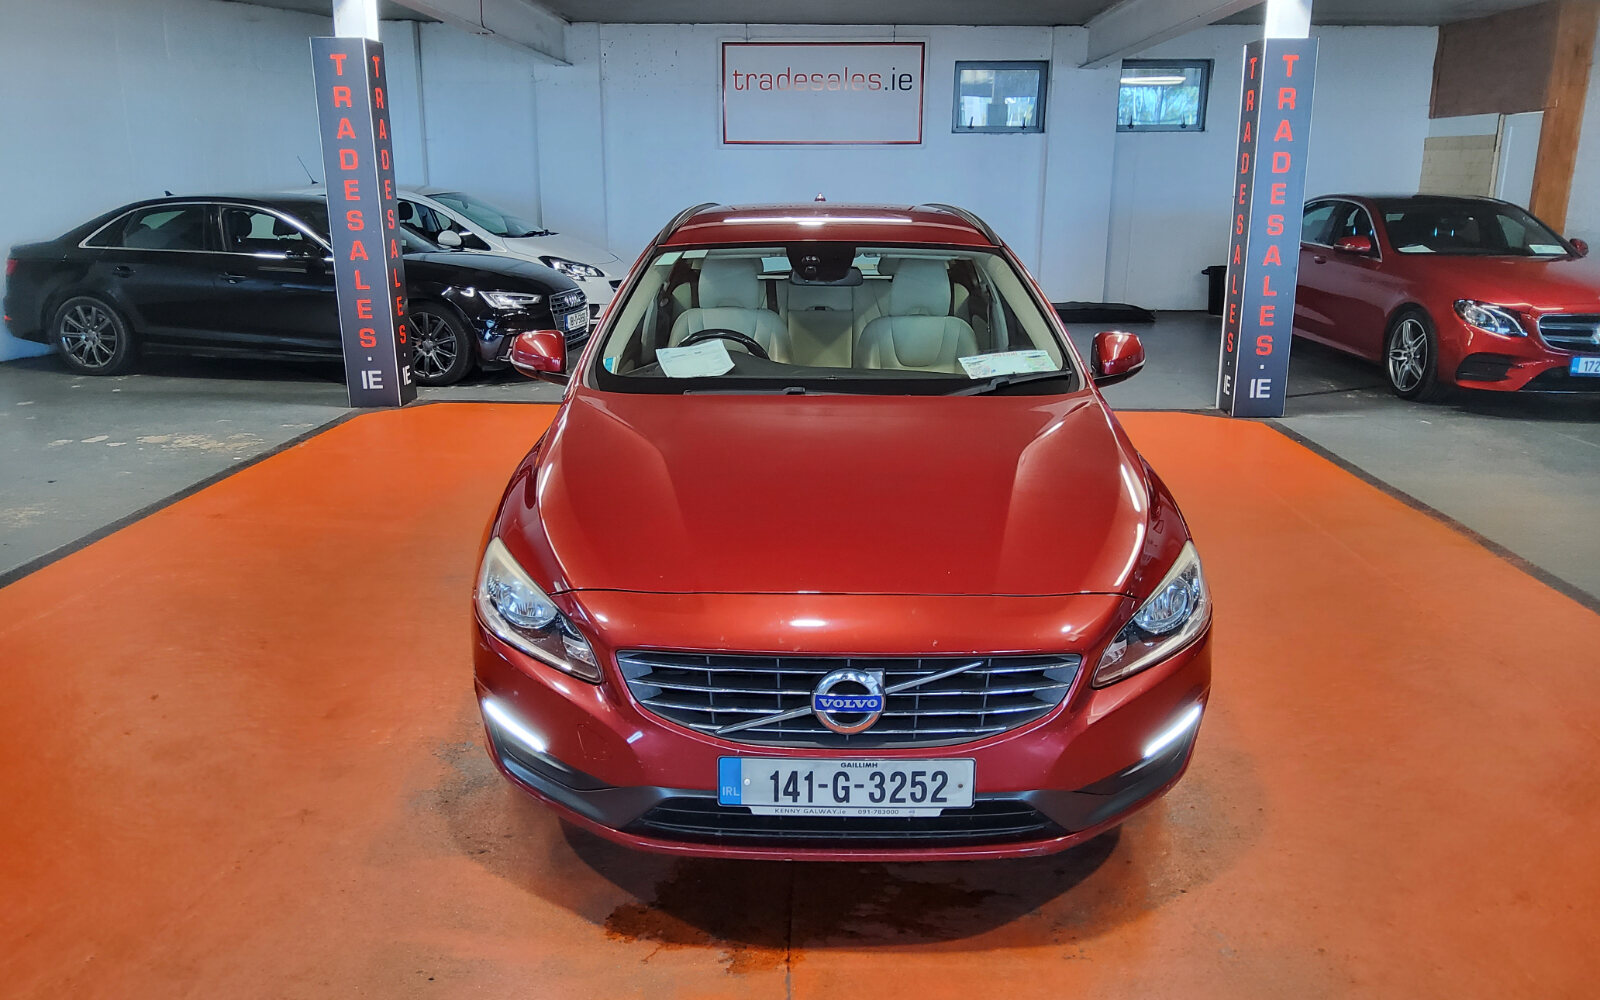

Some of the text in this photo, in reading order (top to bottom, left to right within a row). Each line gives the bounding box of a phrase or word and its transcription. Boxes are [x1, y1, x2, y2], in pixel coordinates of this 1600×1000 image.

[732, 67, 913, 91] tradesales.ie
[818, 698, 879, 708] VOLVO
[722, 786, 740, 797] IRL
[769, 770, 949, 804] 141-G-3252
